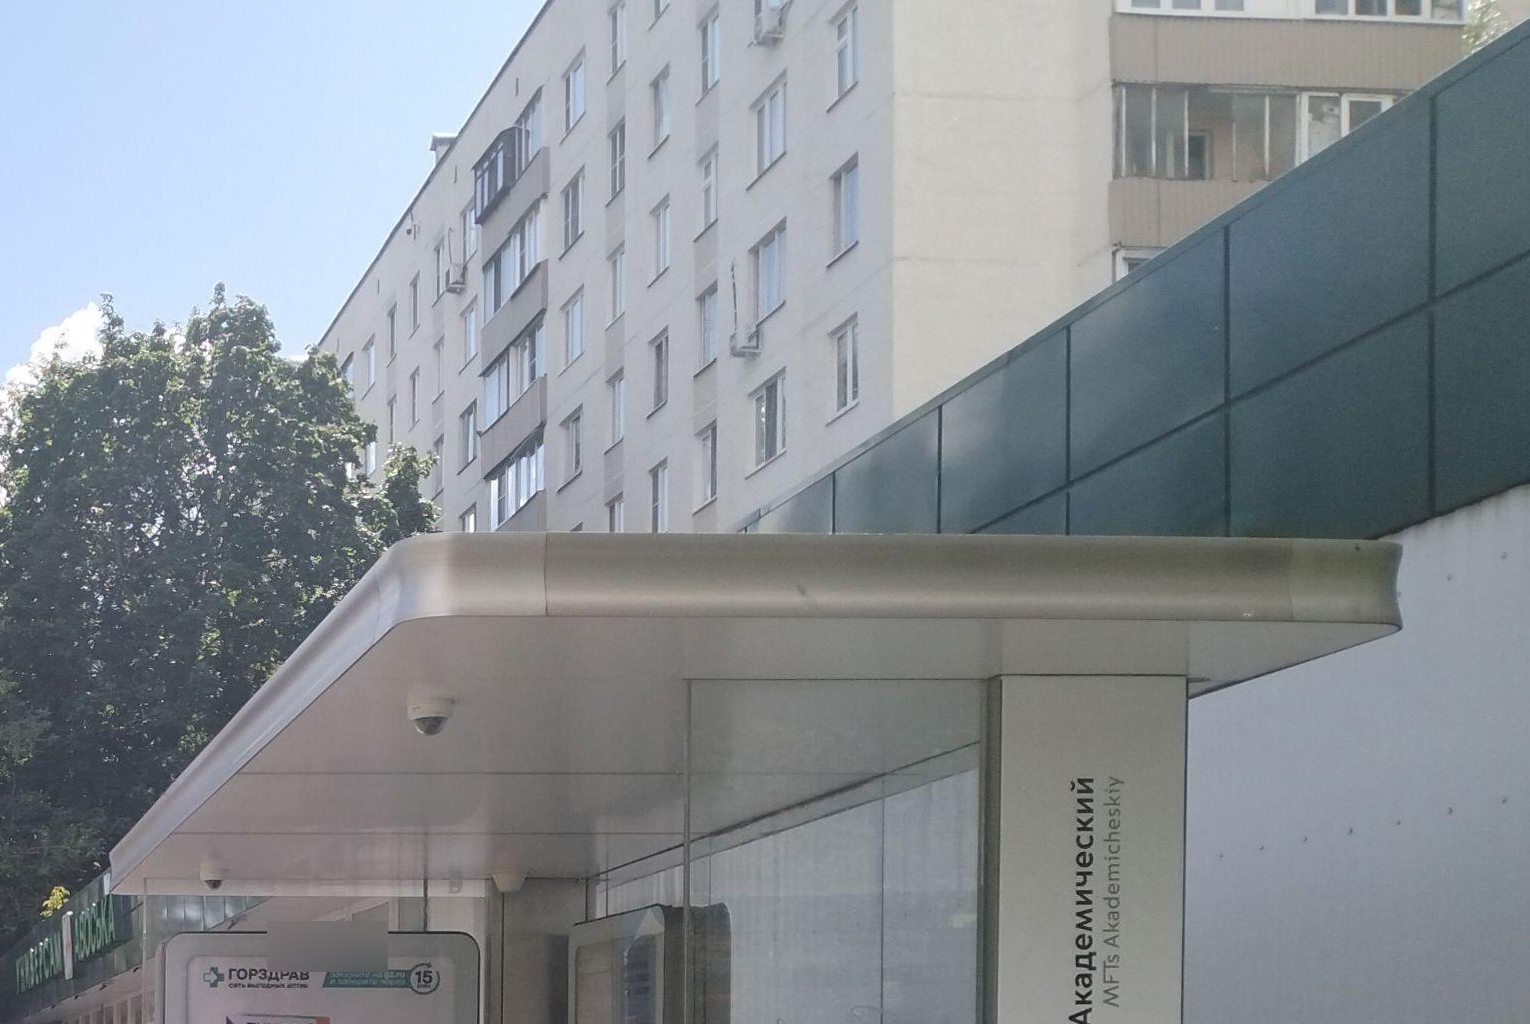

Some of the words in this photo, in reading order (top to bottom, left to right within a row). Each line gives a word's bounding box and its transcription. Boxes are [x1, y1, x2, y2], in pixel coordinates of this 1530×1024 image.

[1103, 776, 1125, 948] Akademicheskiy
[415, 970, 433, 984] 15
[1103, 953, 1120, 1008] MFTs
